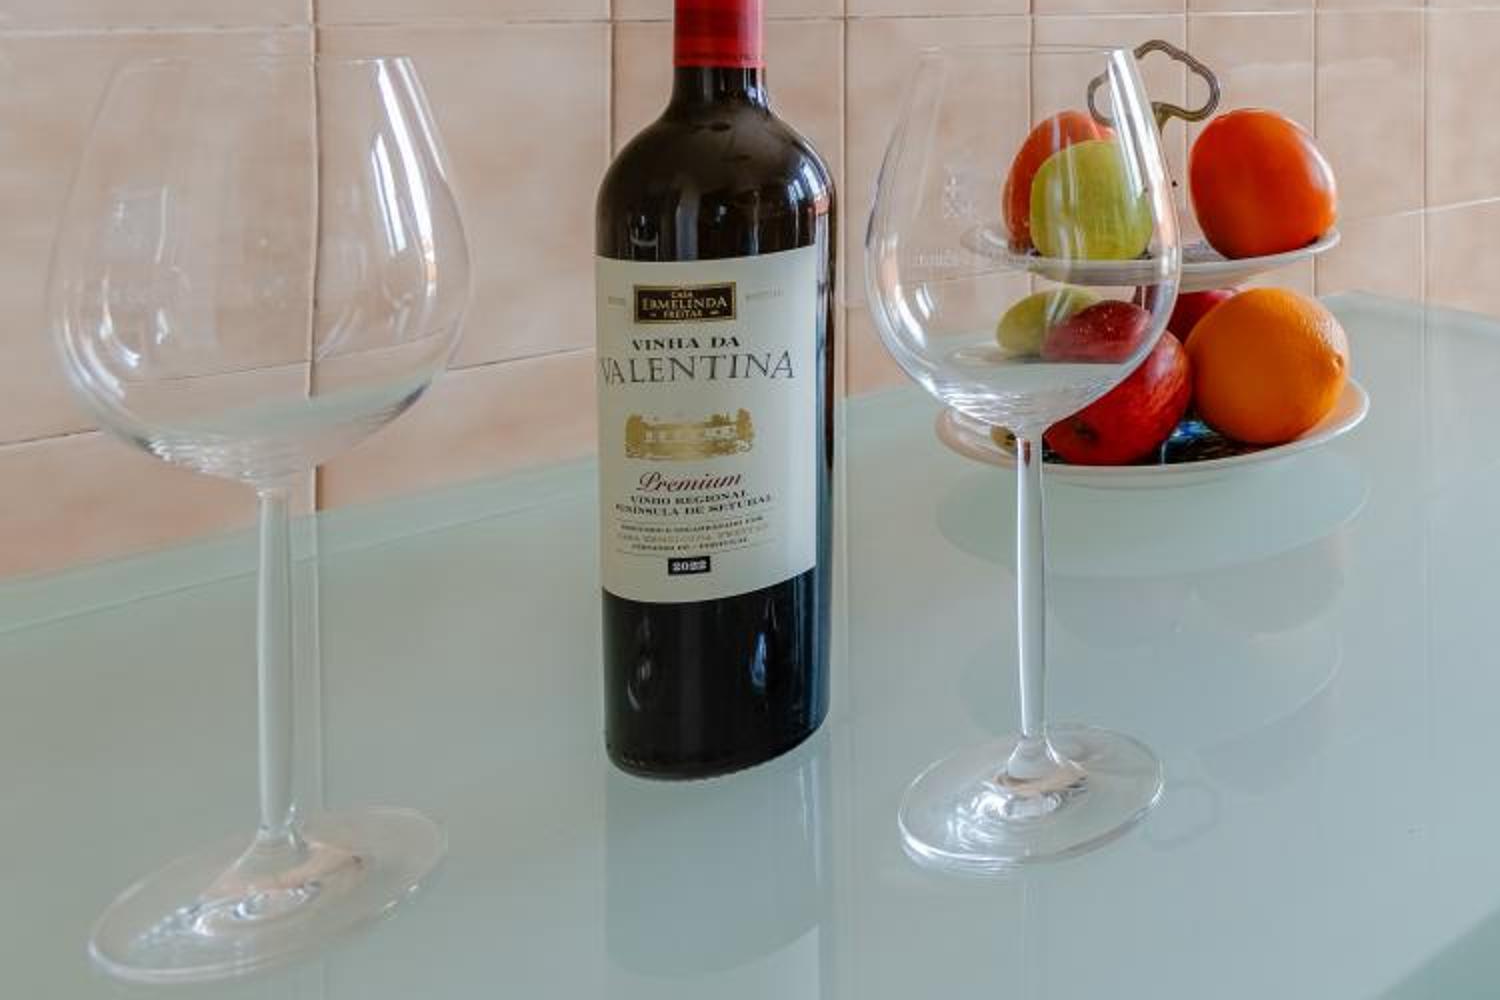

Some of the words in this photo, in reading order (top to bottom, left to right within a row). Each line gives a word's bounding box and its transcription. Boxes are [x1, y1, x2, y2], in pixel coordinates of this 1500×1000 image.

[632, 337, 699, 351] VINHA
[711, 335, 740, 348] DA
[601, 349, 796, 384] VALENTINA
[636, 471, 742, 493] Premium
[630, 495, 671, 506] VINHO
[675, 490, 749, 504] REGIONAL
[685, 505, 704, 515] DE
